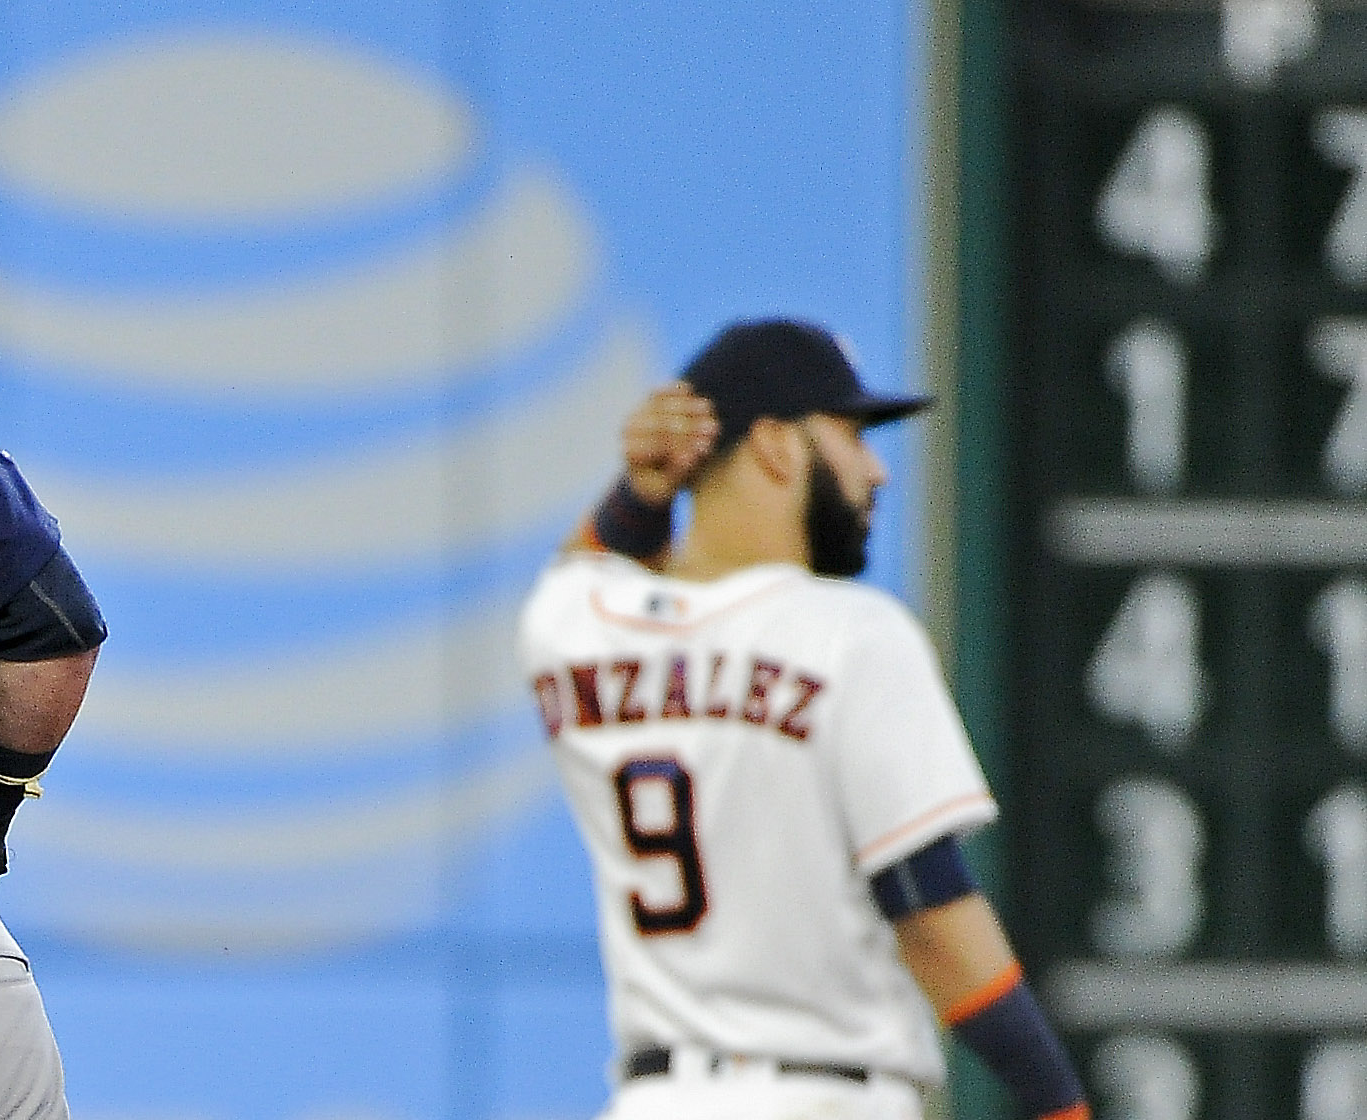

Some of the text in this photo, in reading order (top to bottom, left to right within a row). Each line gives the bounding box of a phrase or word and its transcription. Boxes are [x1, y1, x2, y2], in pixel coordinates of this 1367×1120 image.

[1098, 108, 1214, 282] 4
[1110, 318, 1188, 492] 1
[1088, 574, 1204, 748] 4
[613, 753, 711, 936] 9
[1096, 778, 1205, 958] 3
